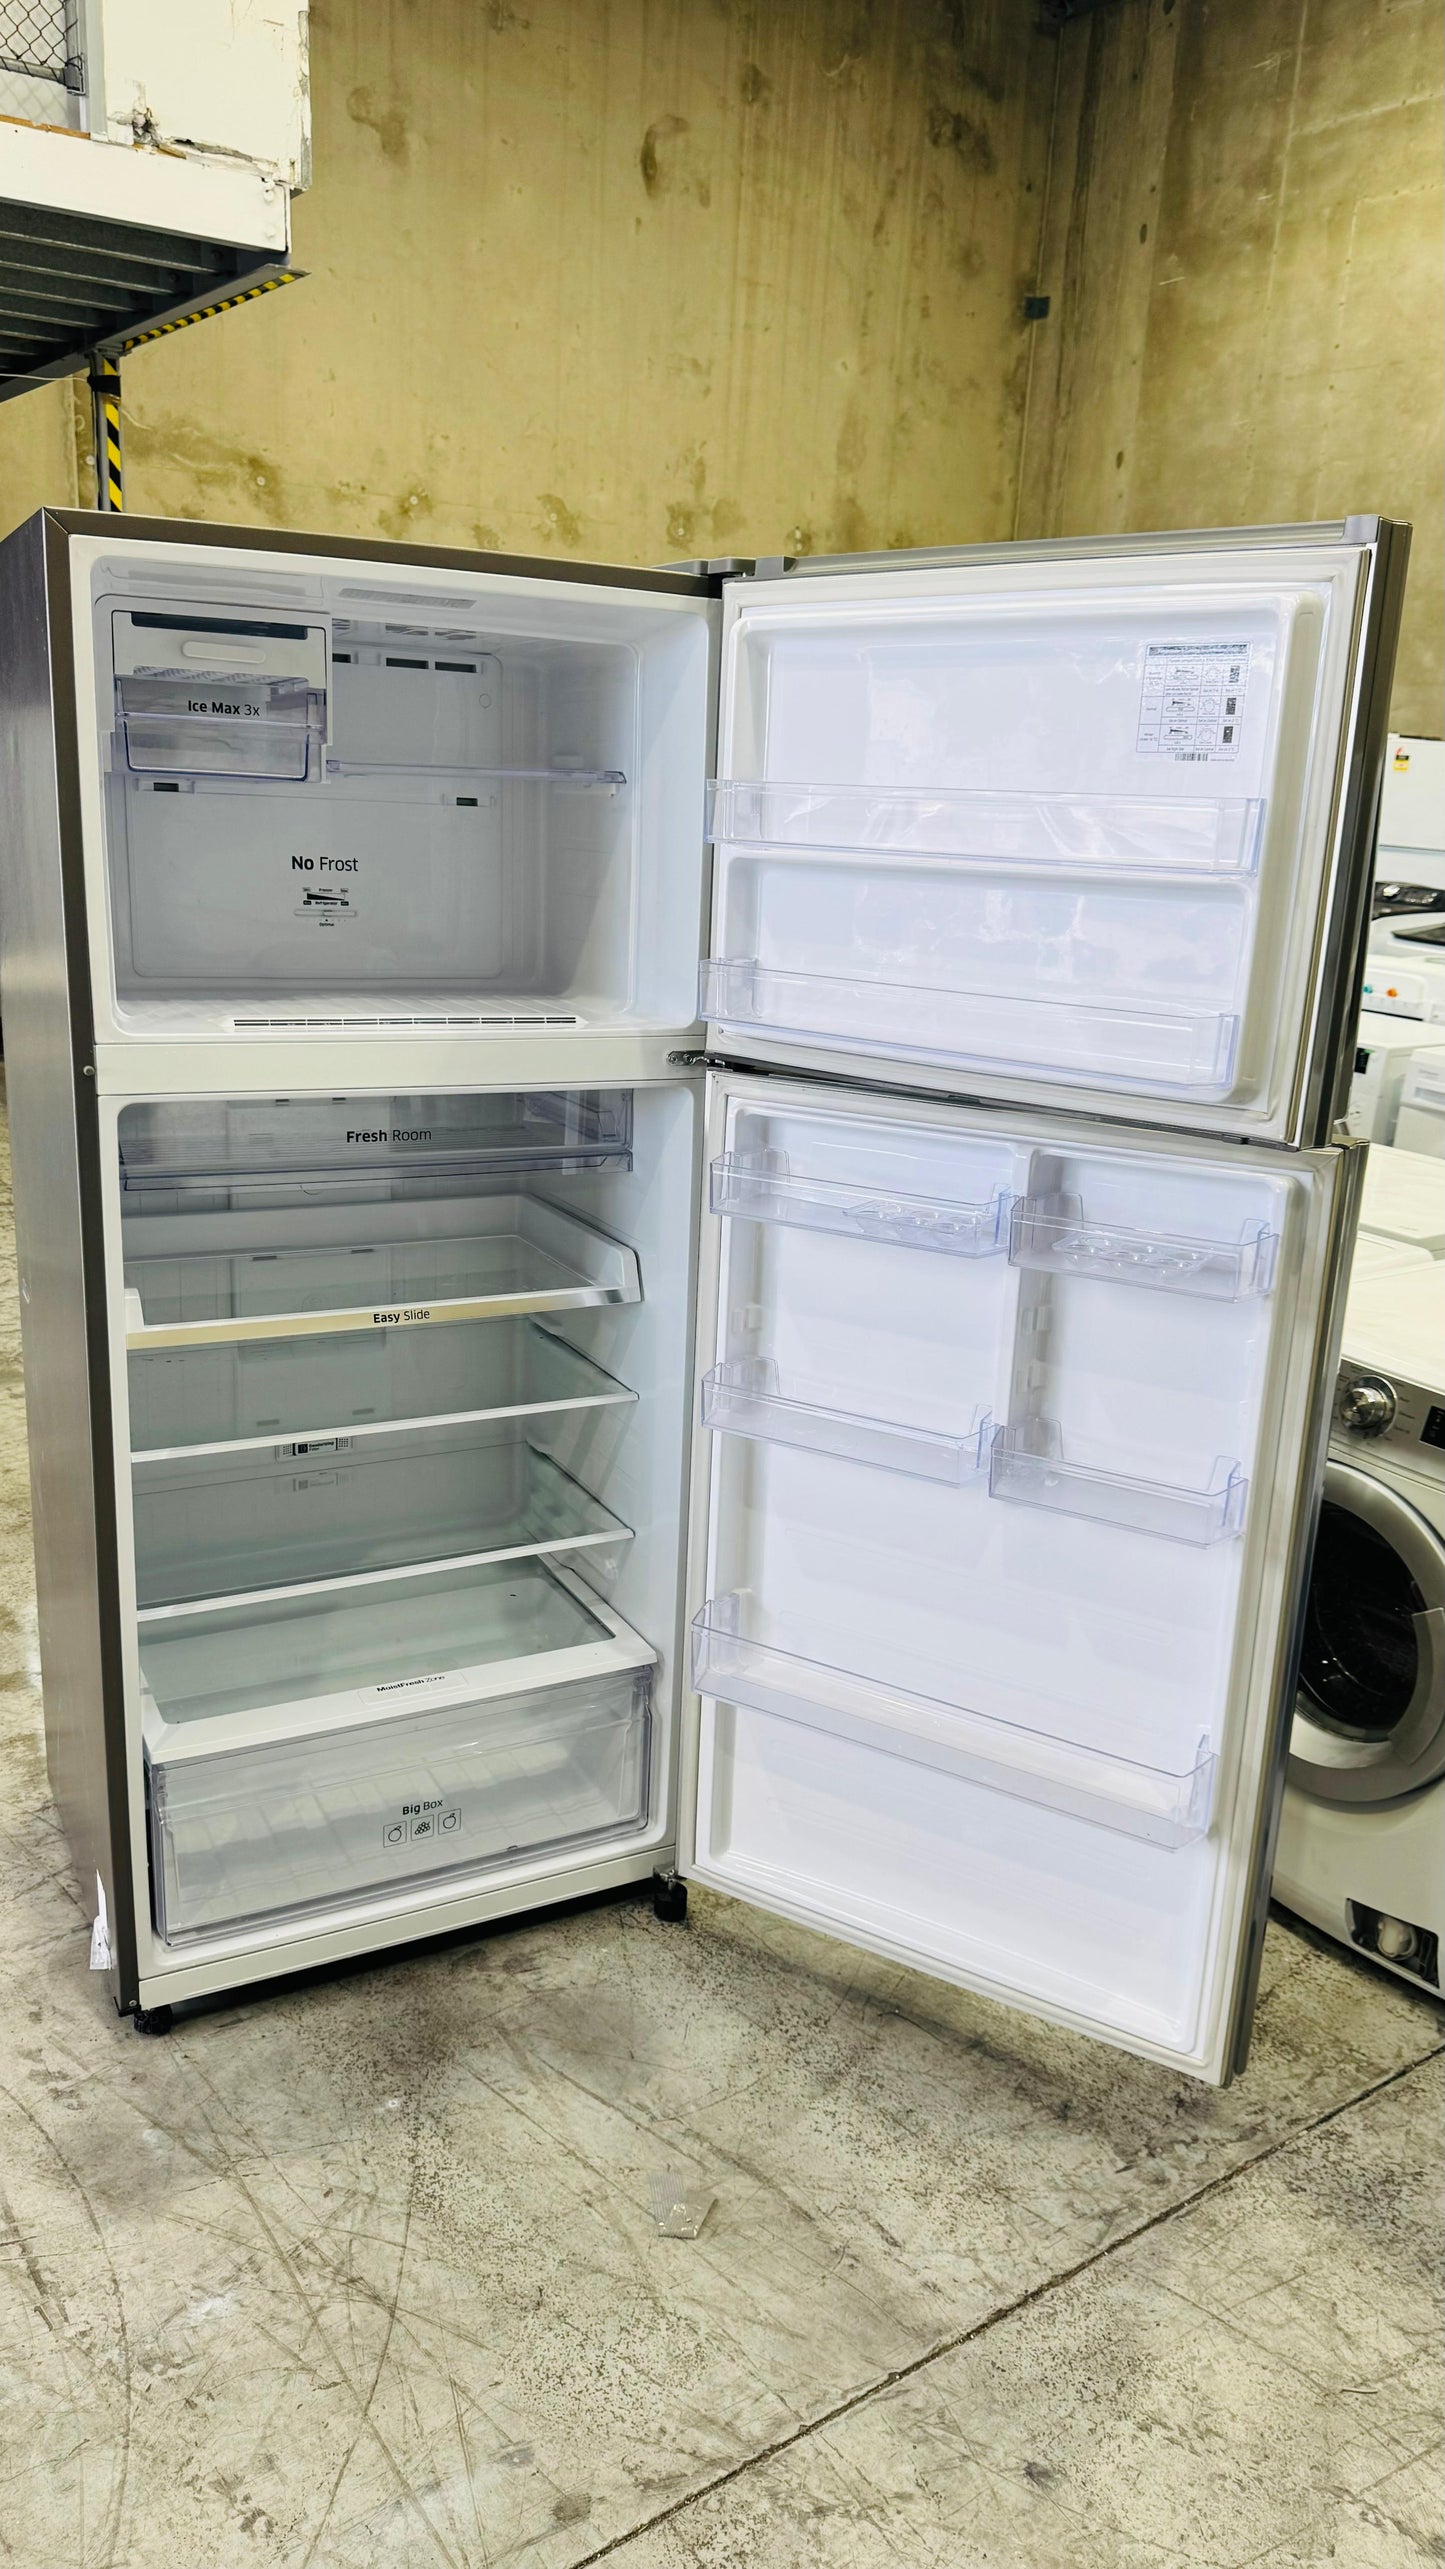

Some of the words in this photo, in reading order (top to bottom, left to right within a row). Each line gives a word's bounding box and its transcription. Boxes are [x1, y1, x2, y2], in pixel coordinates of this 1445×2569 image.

[187, 700, 208, 713] Ice
[211, 701, 241, 715] Max
[243, 704, 261, 717] 3x
[291, 855, 315, 871] No
[319, 856, 359, 872] Frost
[346, 1129, 388, 1143] Fresh
[392, 1129, 432, 1142] Room
[373, 1313, 400, 1324] Easy
[403, 1309, 430, 1321] Slide
[402, 1804, 421, 1815] Big
[423, 1800, 443, 1811] Box
